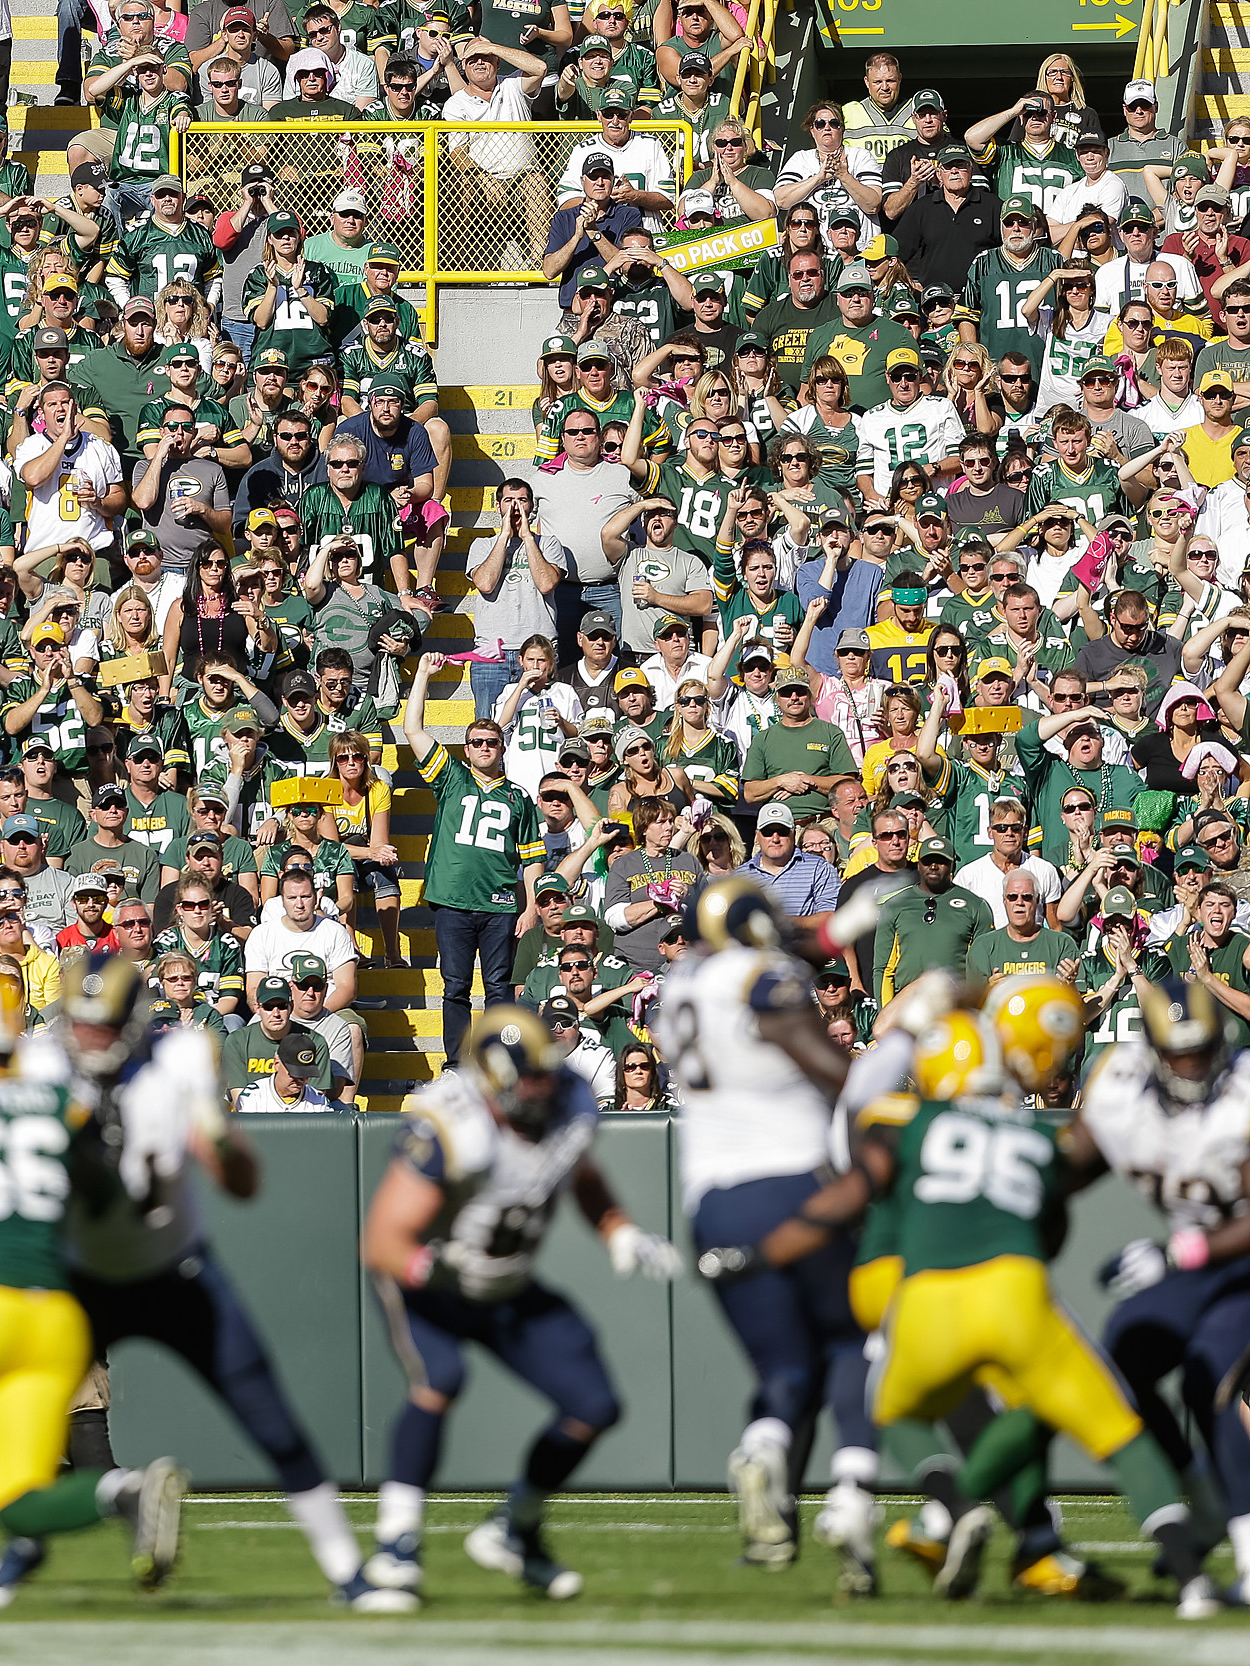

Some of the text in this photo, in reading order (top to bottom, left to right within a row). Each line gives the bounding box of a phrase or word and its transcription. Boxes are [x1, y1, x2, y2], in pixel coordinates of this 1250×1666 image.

[119, 122, 162, 171] 12
[865, 142, 909, 158] POLIC
[1012, 164, 1074, 206] 52
[689, 237, 739, 264] PACK
[740, 230, 764, 248] GO
[995, 280, 1041, 329] 12
[772, 332, 808, 351] GREEN
[495, 391, 512, 405] 21
[492, 441, 515, 456] 20
[885, 423, 928, 470] 12
[59, 474, 82, 521] 8
[678, 487, 722, 540] 18
[636, 559, 672, 583] G
[887, 652, 928, 684] 12
[38, 700, 86, 752] 52
[518, 709, 560, 751] 52
[131, 817, 167, 830] PACKERS
[455, 794, 511, 853] 12
[1103, 810, 1132, 821] PACKERS
[25, 900, 53, 909] KERS
[38, 893, 56, 901] BAY
[1003, 961, 1046, 975] PACKERS
[914, 1110, 1055, 1218] 95
